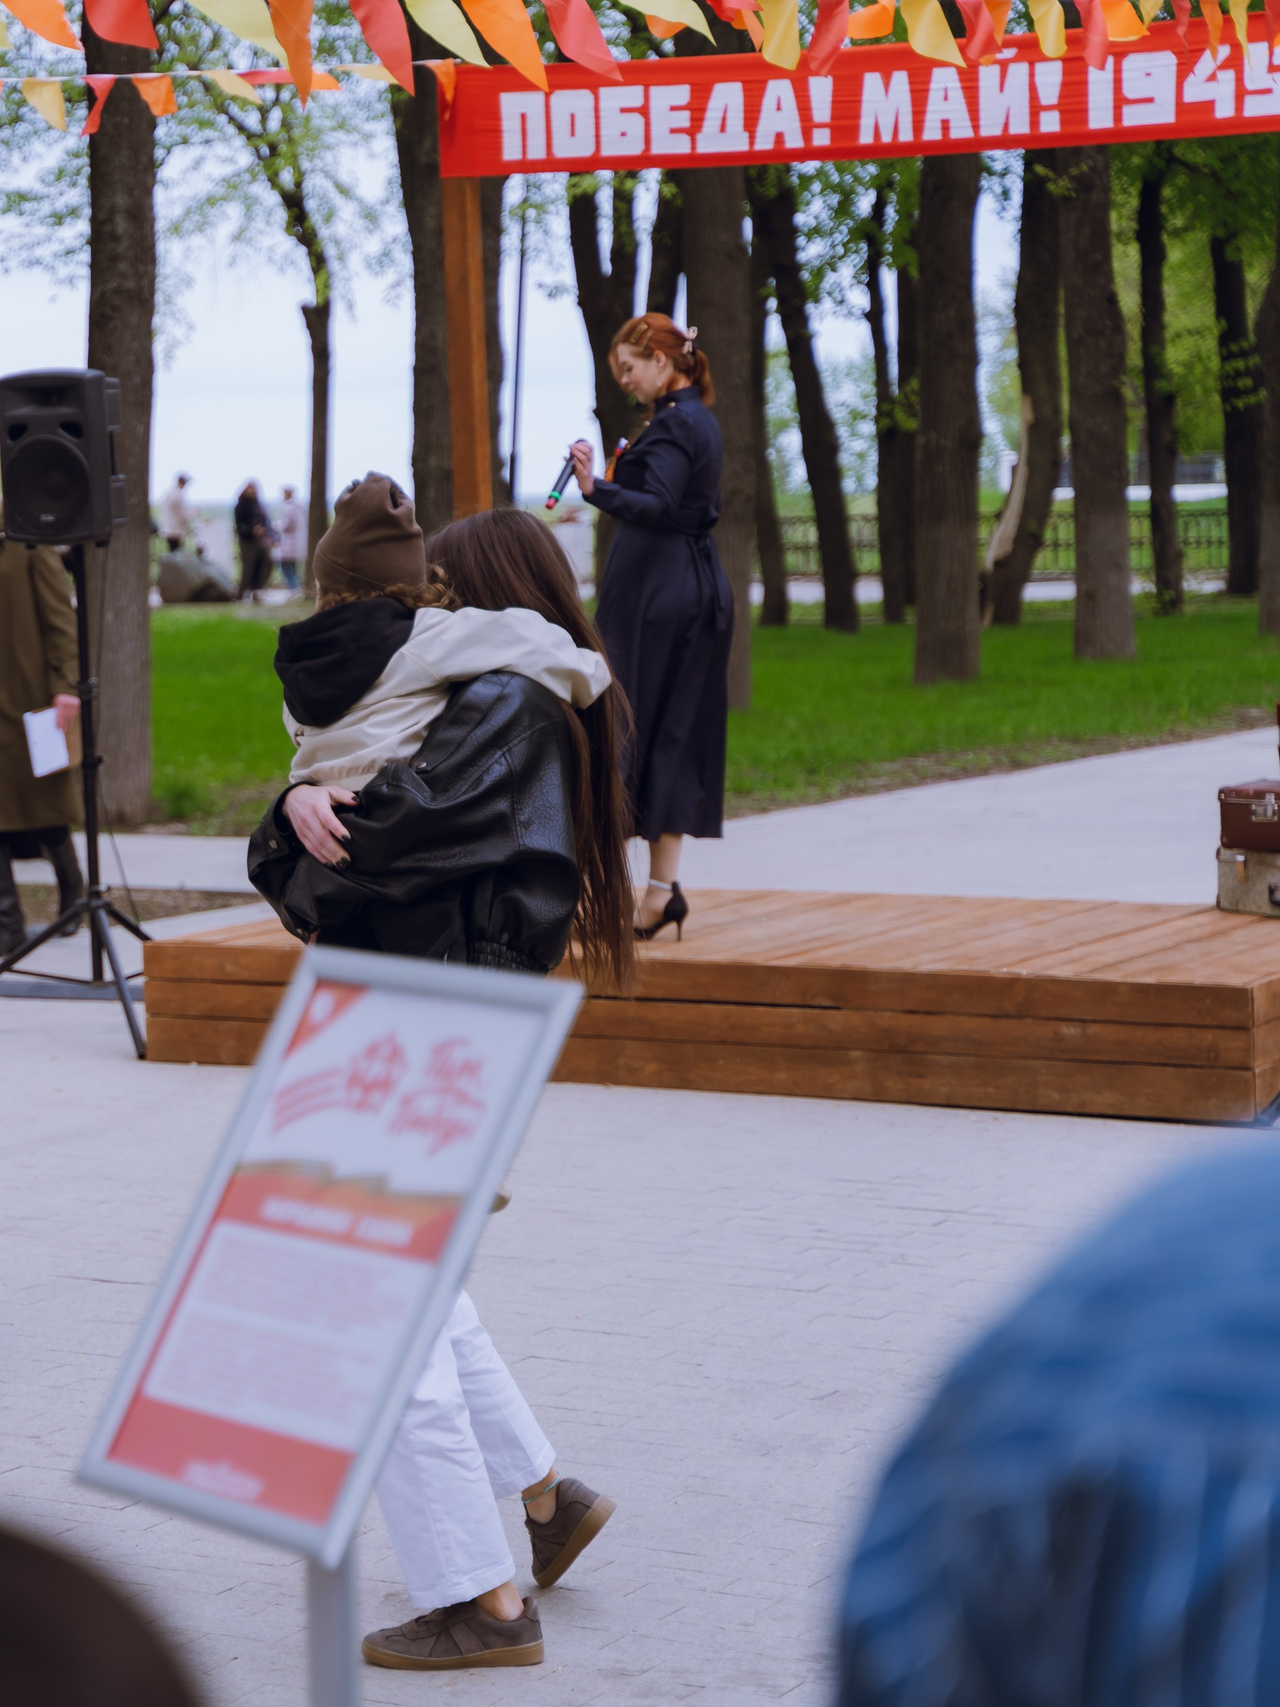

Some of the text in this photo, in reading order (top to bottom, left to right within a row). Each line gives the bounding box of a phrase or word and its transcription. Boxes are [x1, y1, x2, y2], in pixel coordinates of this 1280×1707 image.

[500, 41, 1280, 161] ПОБЕДА! МАЙ! 1945
